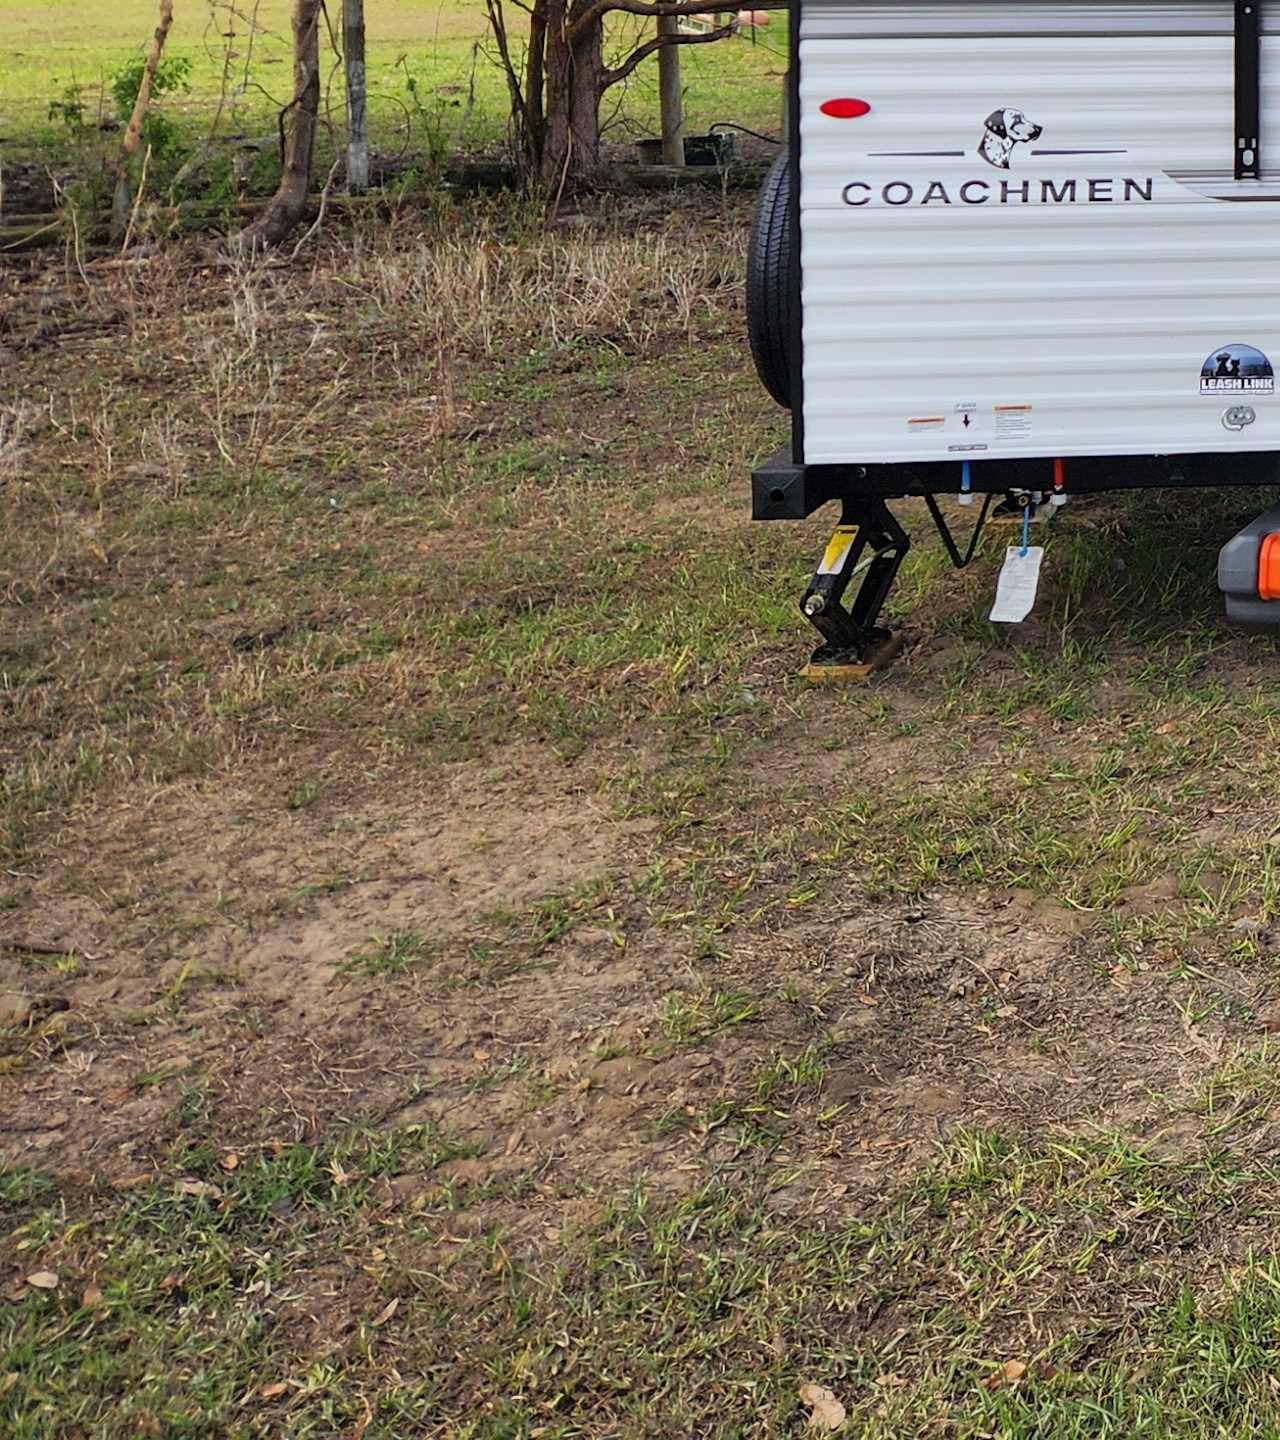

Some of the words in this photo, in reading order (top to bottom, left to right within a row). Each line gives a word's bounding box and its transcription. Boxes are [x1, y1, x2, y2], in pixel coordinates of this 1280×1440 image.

[841, 177, 1153, 206] COACHMEN
[1201, 378, 1242, 389] LEASH
[1244, 378, 1273, 389] LINK
